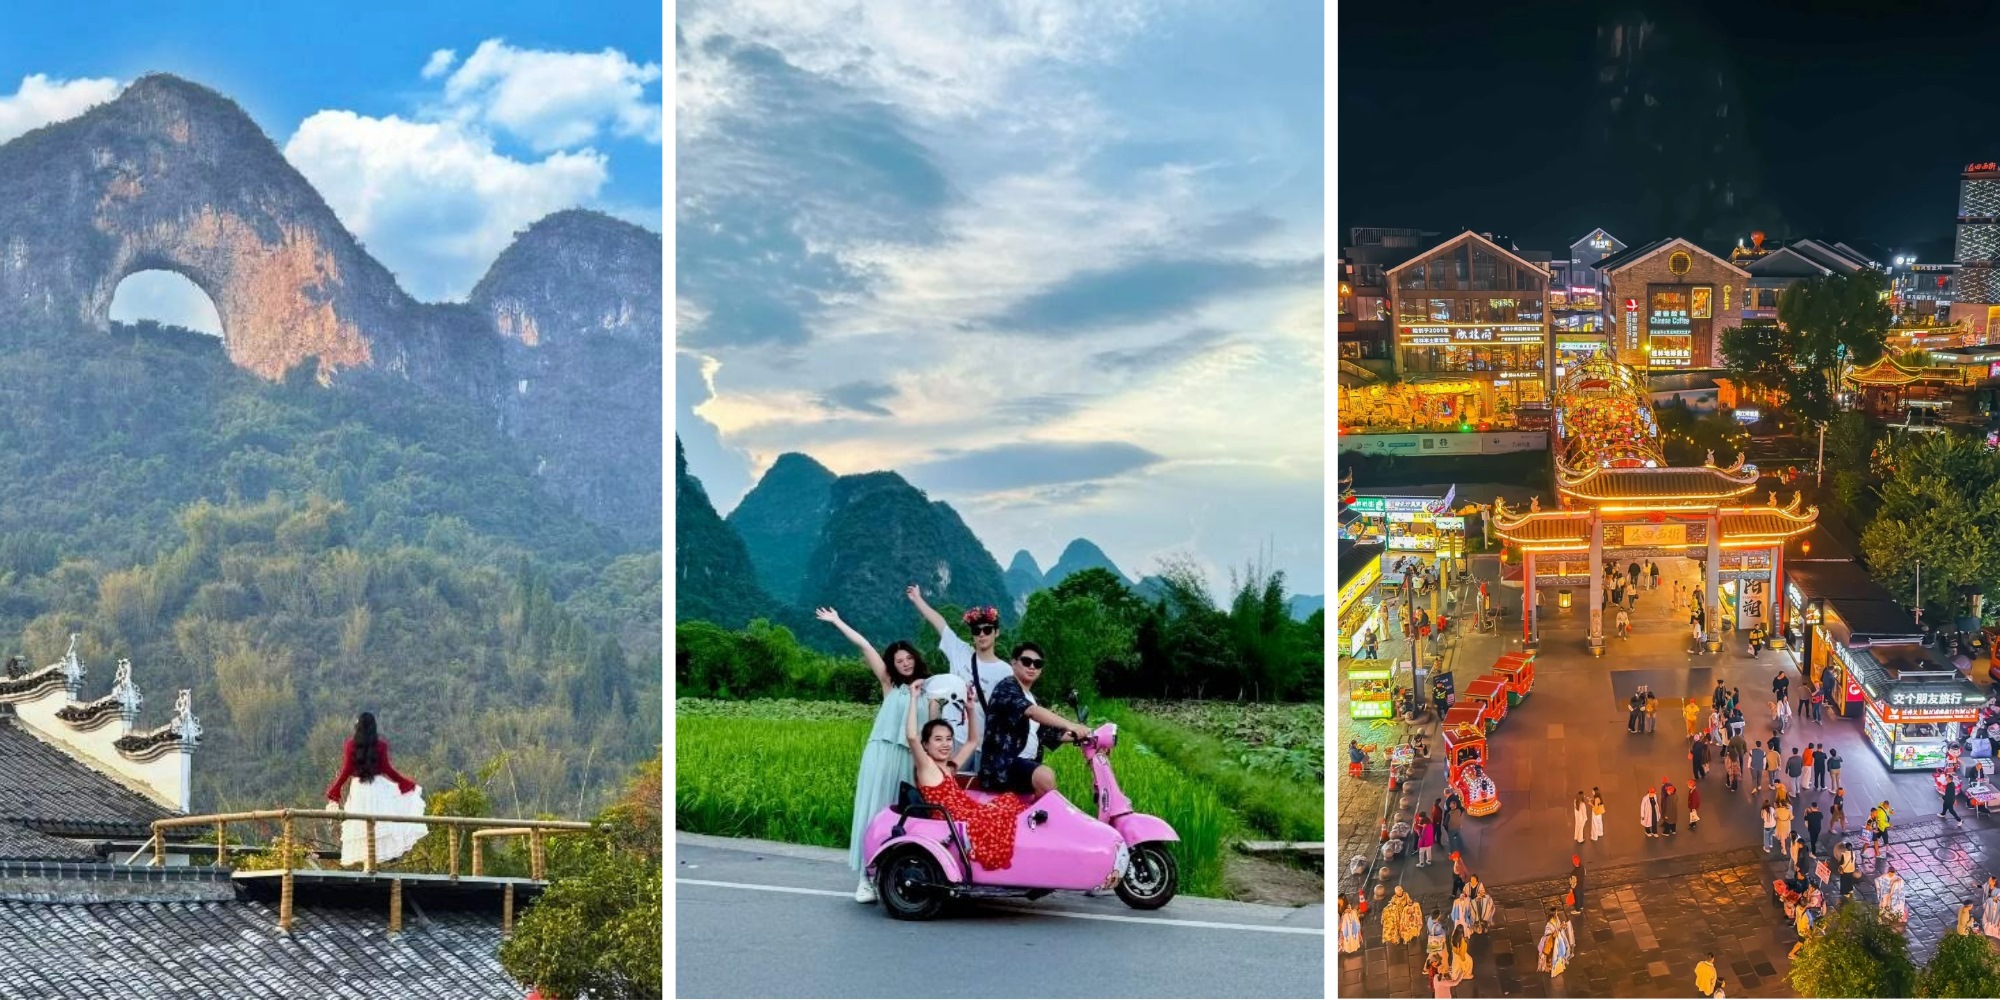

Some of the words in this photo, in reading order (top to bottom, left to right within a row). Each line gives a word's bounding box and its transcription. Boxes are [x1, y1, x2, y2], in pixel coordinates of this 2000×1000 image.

[1650, 316, 1671, 325] Chinese
[1672, 316, 1690, 325] Coffee
[1742, 579, 1763, 618] 阳朔
[1893, 692, 1963, 705] 交个朋友旅行
